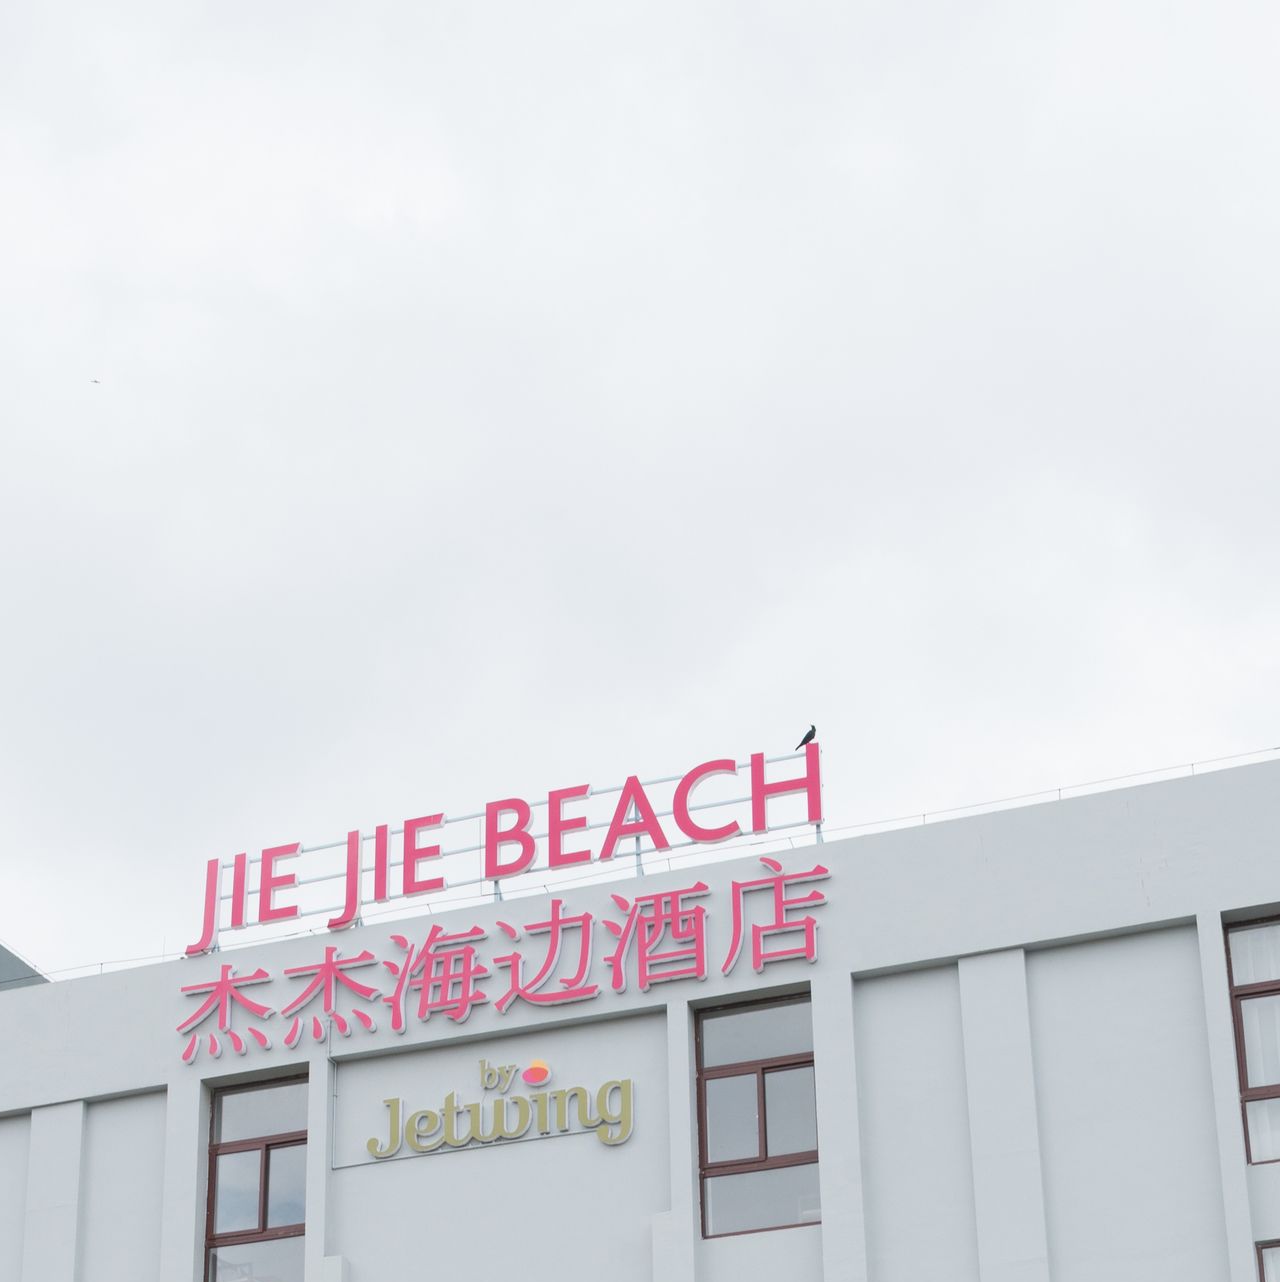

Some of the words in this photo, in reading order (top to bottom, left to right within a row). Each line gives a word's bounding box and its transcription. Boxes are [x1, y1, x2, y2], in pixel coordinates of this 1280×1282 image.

[185, 842, 303, 957] JIE
[327, 812, 448, 931] JIE
[484, 742, 824, 881] BEACH
[176, 856, 831, 1064] 杰杰海边酒店
[366, 1078, 634, 1159] Jetwing
[479, 1059, 518, 1093] by
